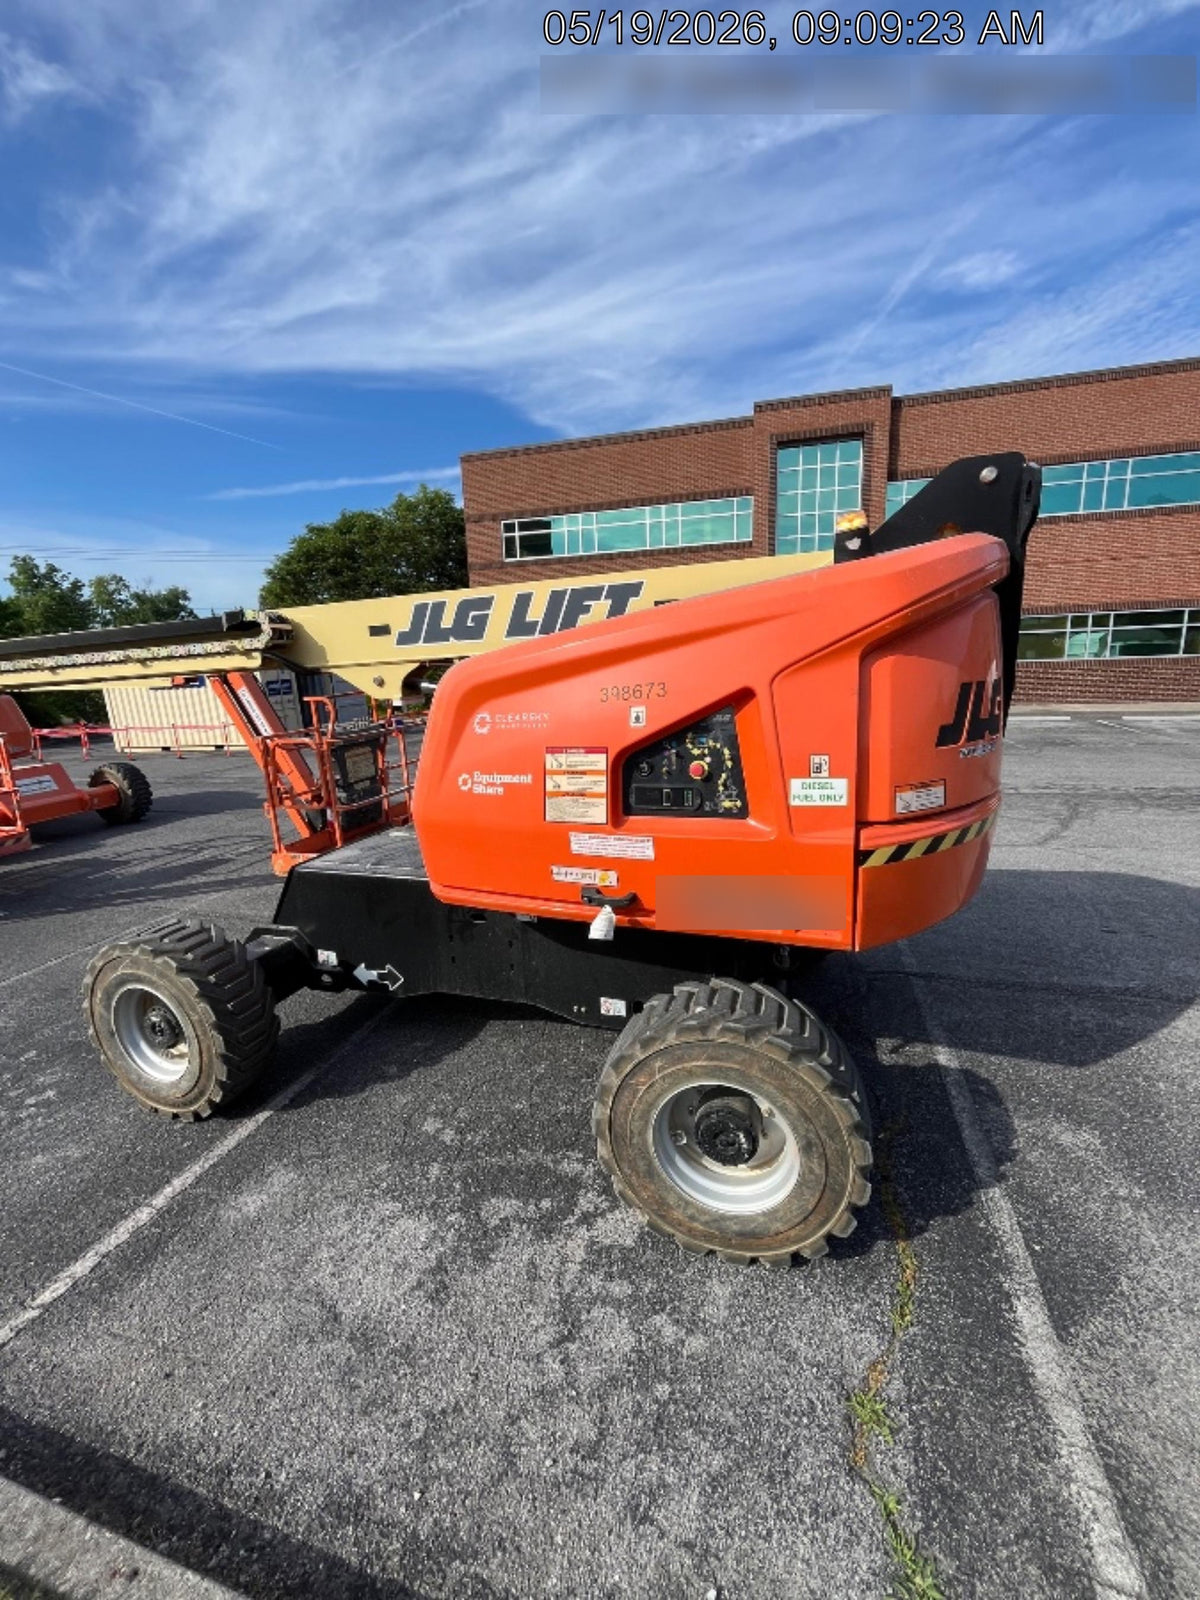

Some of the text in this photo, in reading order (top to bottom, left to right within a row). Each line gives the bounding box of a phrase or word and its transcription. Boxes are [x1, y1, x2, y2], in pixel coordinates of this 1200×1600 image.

[395, 579, 647, 646] JLG LIFT
[473, 771, 532, 784] Equipment
[472, 784, 504, 795] Share
[801, 781, 835, 790] DIESEL
[792, 794, 844, 802] FUEL ONLY
